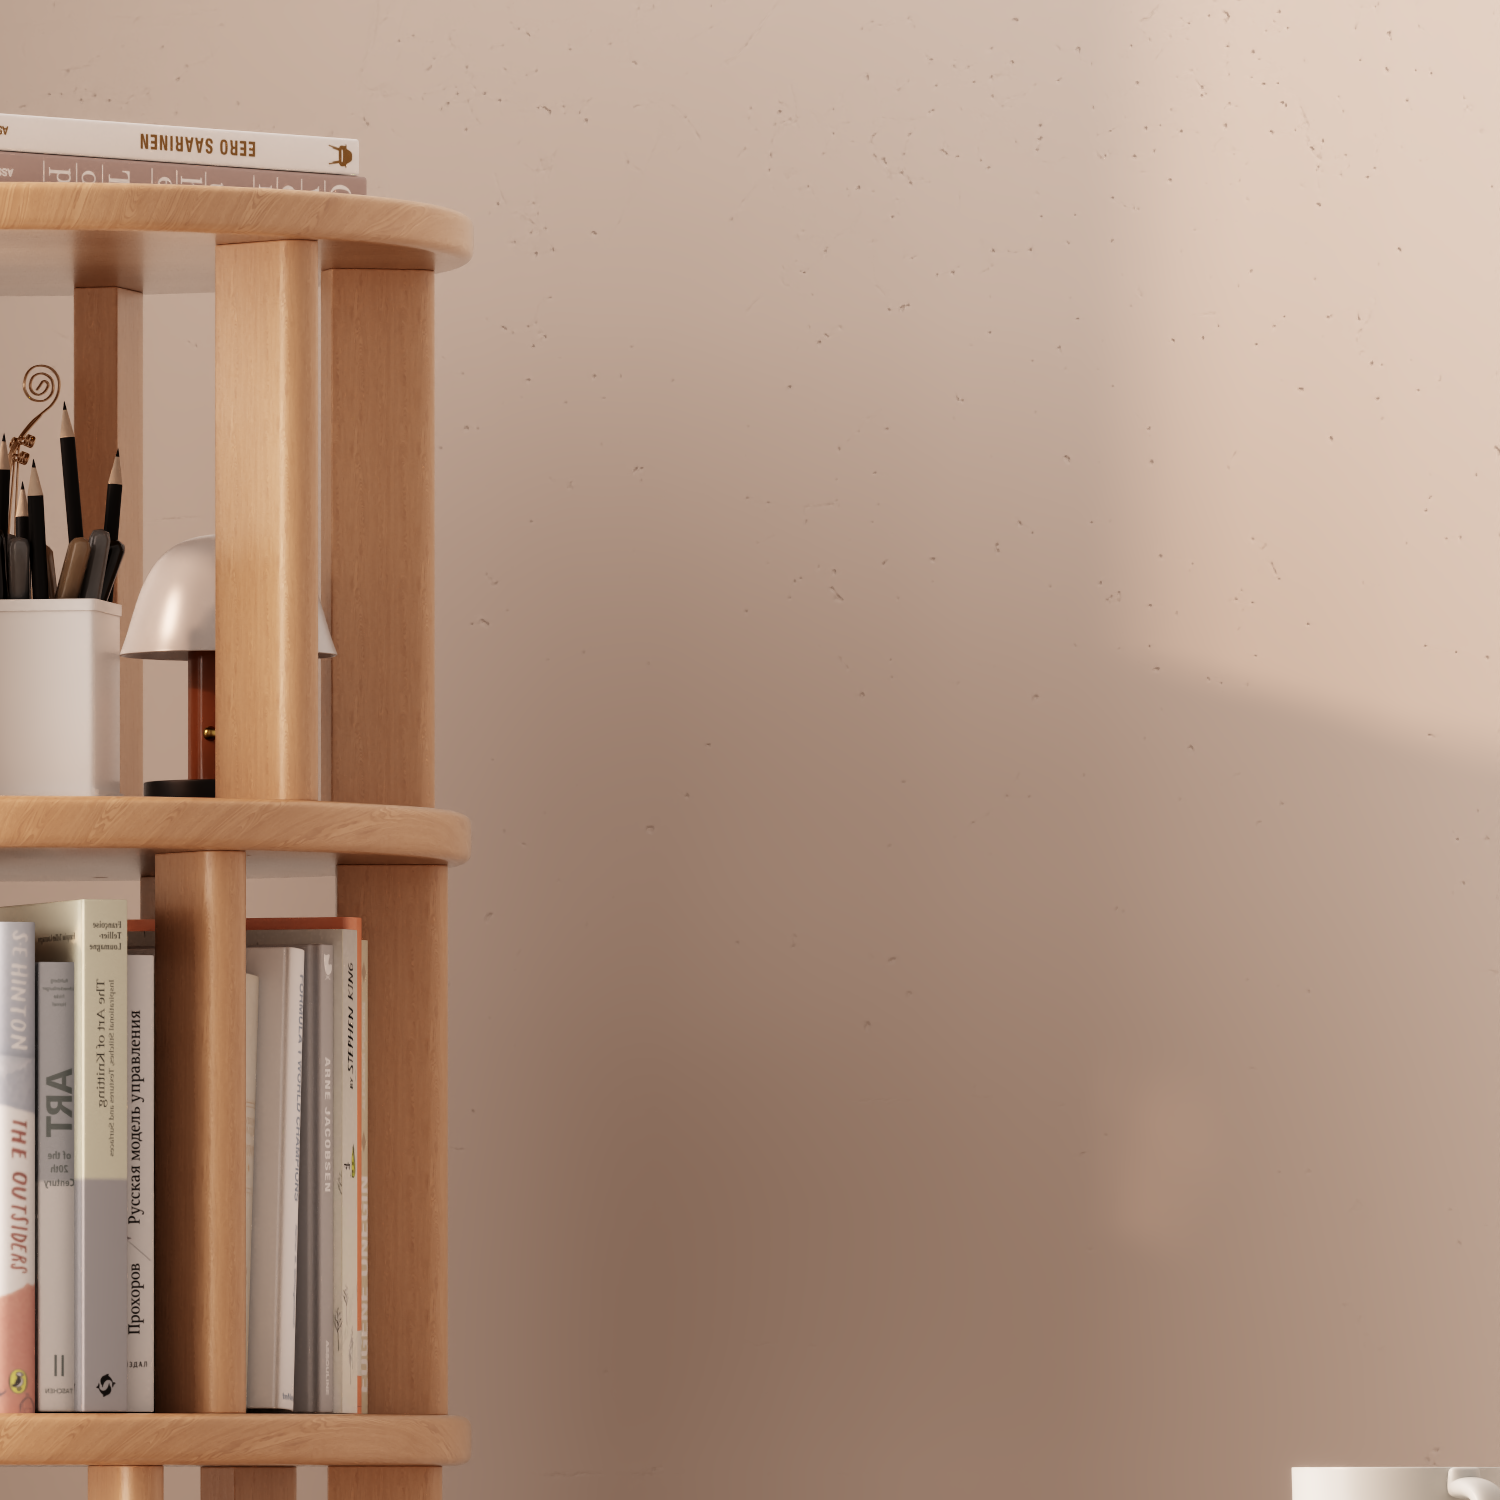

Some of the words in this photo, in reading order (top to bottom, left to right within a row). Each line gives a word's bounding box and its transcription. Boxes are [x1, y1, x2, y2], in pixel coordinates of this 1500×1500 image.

[140, 133, 213, 155] SAARINEN
[220, 139, 256, 157] EERO
[10, 963, 28, 1050] HINTON
[127, 1010, 144, 1104] управления
[324, 1056, 332, 1100] ARNE
[348, 1075, 354, 1090] BY
[12, 1120, 28, 1158] THE
[127, 1106, 142, 1161] модель
[324, 1106, 332, 1193] JACOBSEN
[10, 1173, 28, 1274] OUTSIDERS
[127, 1165, 144, 1225] Русская
[127, 1262, 144, 1336] Прохоров
